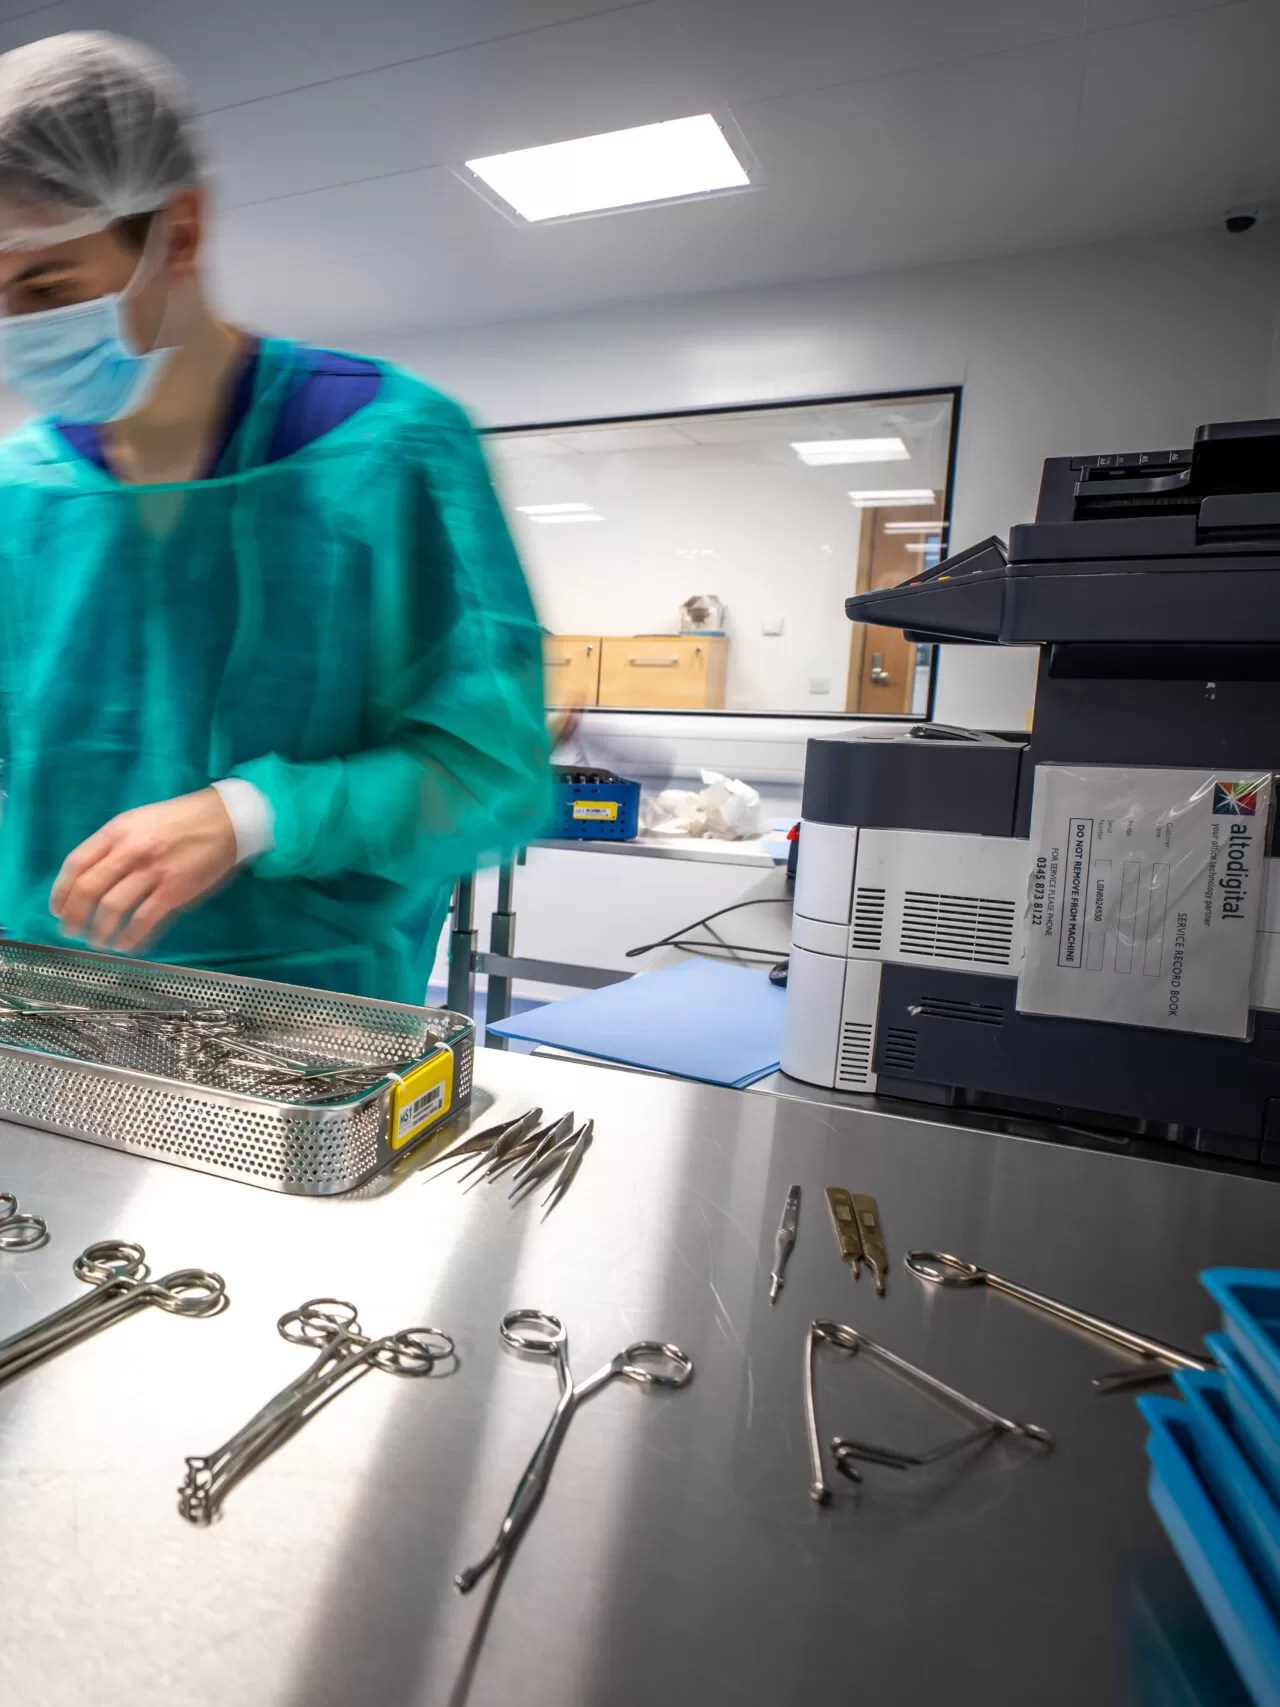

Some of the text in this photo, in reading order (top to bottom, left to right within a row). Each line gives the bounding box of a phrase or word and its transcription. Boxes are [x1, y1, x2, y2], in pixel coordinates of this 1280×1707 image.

[1165, 822, 1174, 849] Customer
[1204, 823, 1220, 927] your office technology partner
[1219, 823, 1252, 920] altodigital
[1032, 856, 1047, 926] 0345 873 8122
[1045, 847, 1059, 936] FOR SERVICE PLEASE PHONE
[1065, 824, 1085, 962] DO NOT REMOVE FROM MACHINE
[1167, 912, 1188, 1017] SERVICE RECORD BOOK
